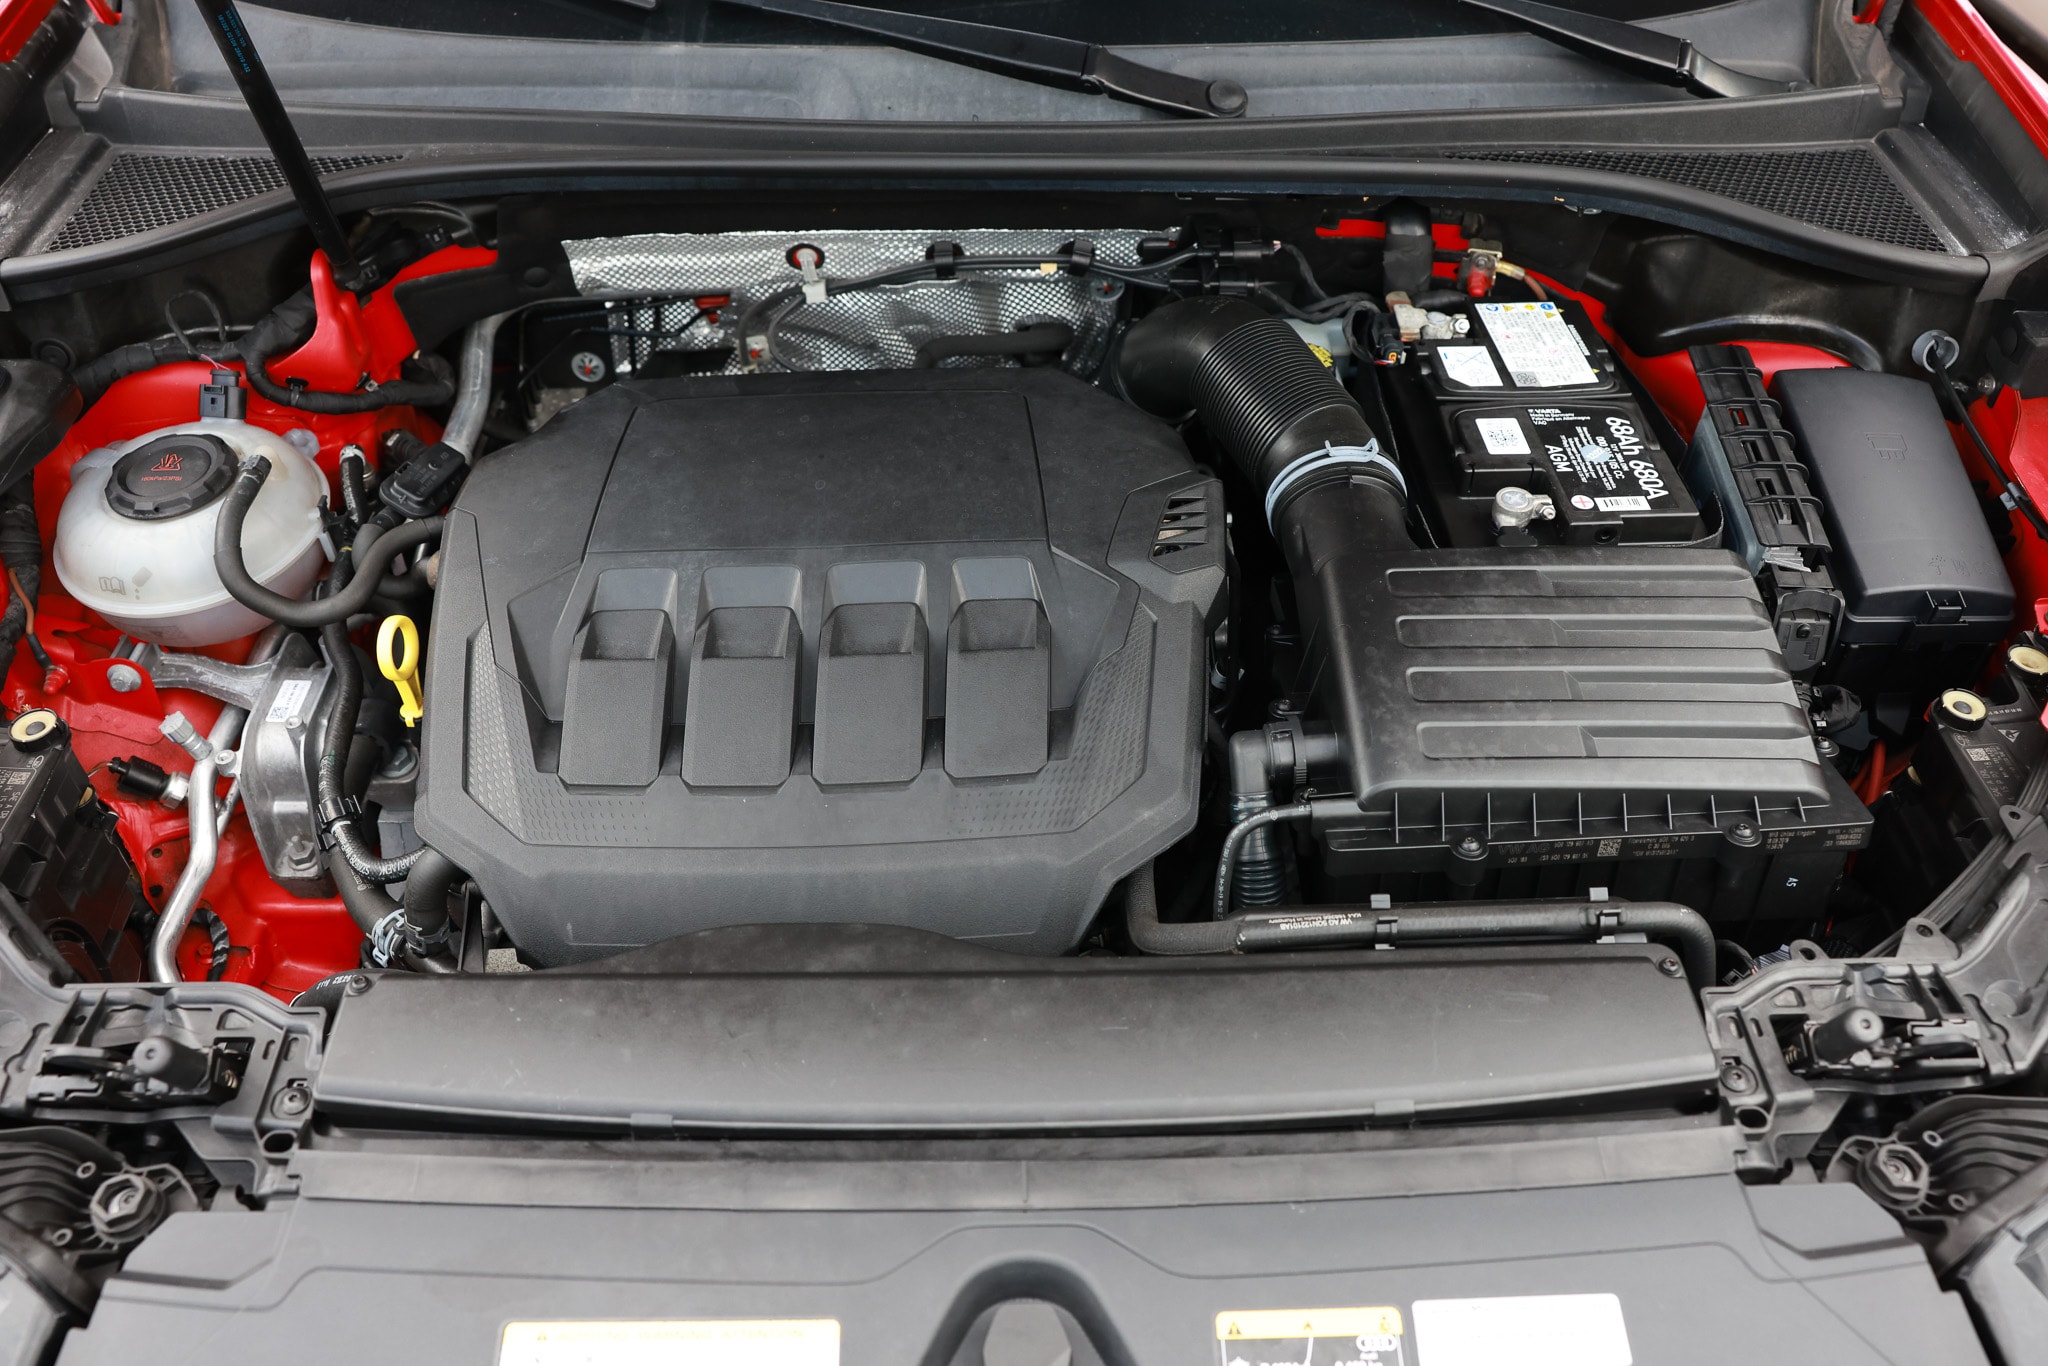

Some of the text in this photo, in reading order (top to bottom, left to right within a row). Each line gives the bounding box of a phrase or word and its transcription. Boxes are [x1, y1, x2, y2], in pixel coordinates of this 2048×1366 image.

[1545, 444, 1574, 472] AGM
[1606, 417, 1669, 500] 68Ah 680A
